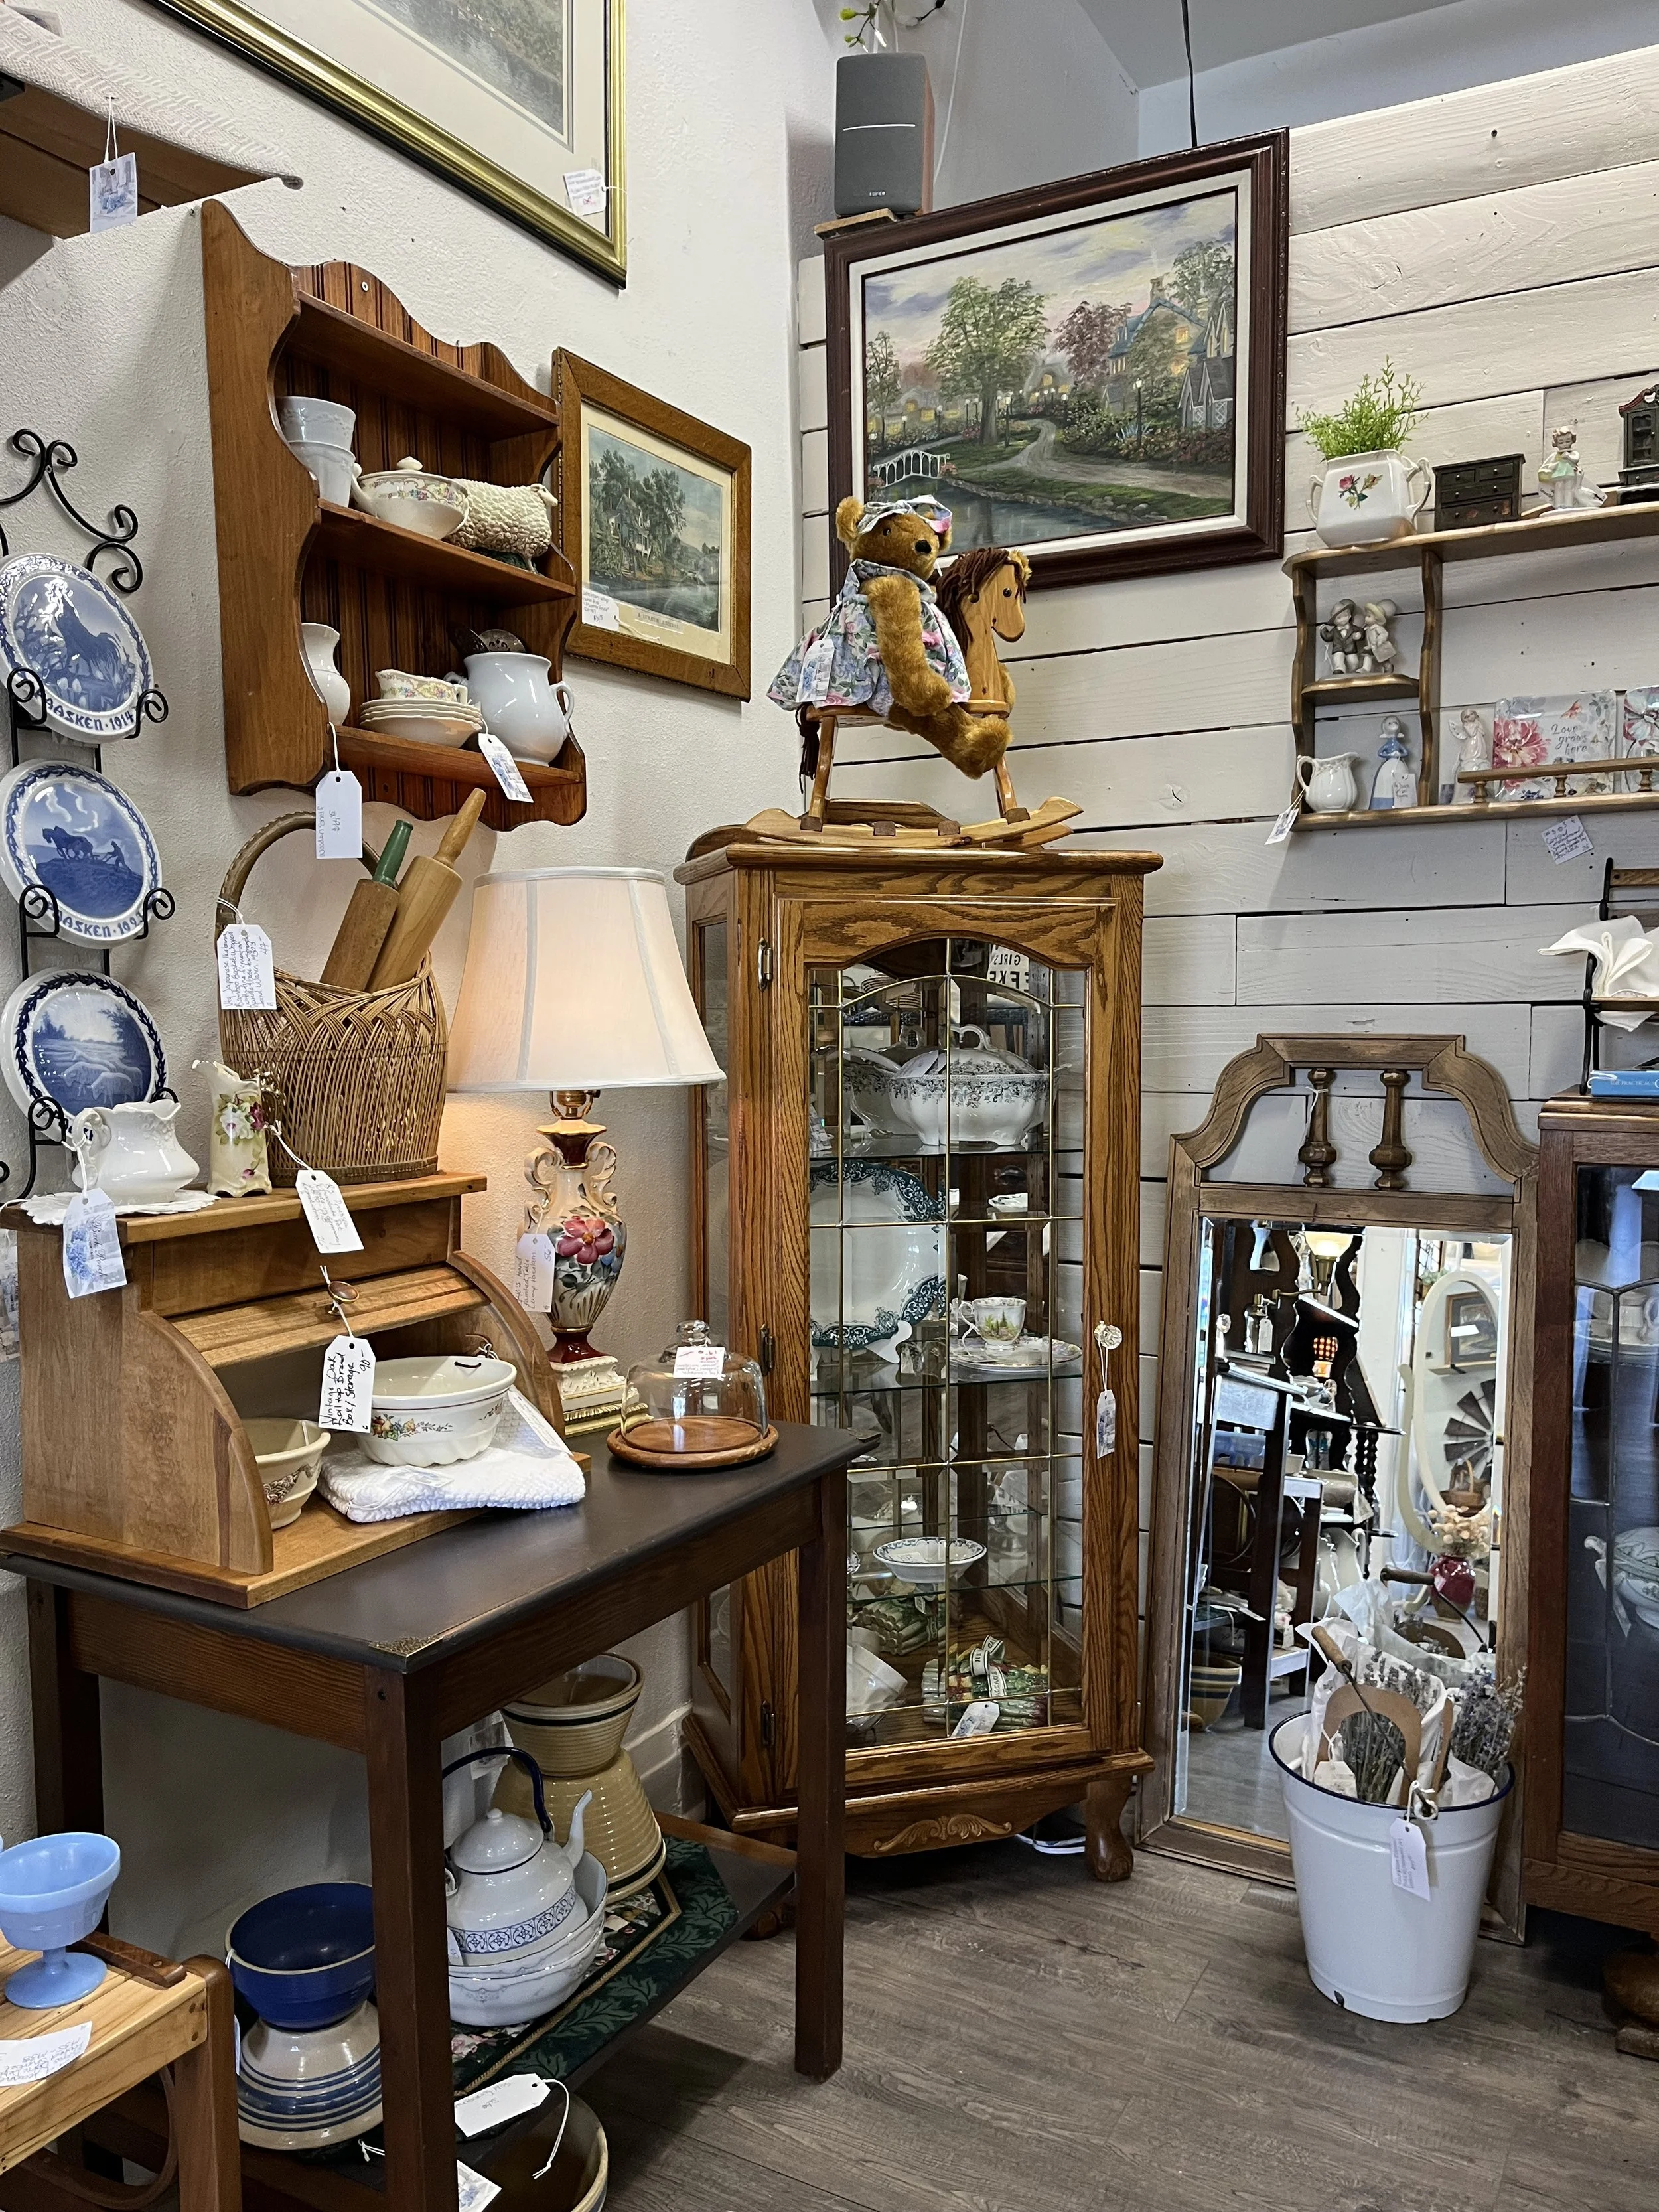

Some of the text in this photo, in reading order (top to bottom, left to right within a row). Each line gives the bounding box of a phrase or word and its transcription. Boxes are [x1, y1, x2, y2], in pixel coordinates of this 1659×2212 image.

[110, 710, 135, 731] 1914
[1551, 723, 1578, 735] Love
[1555, 735, 1587, 750] grows
[1564, 743, 1587, 755] here
[91, 1216, 108, 1278] Back Porch
[319, 1356, 336, 1424] Vintage Oak
[344, 1363, 360, 1398] Storage
